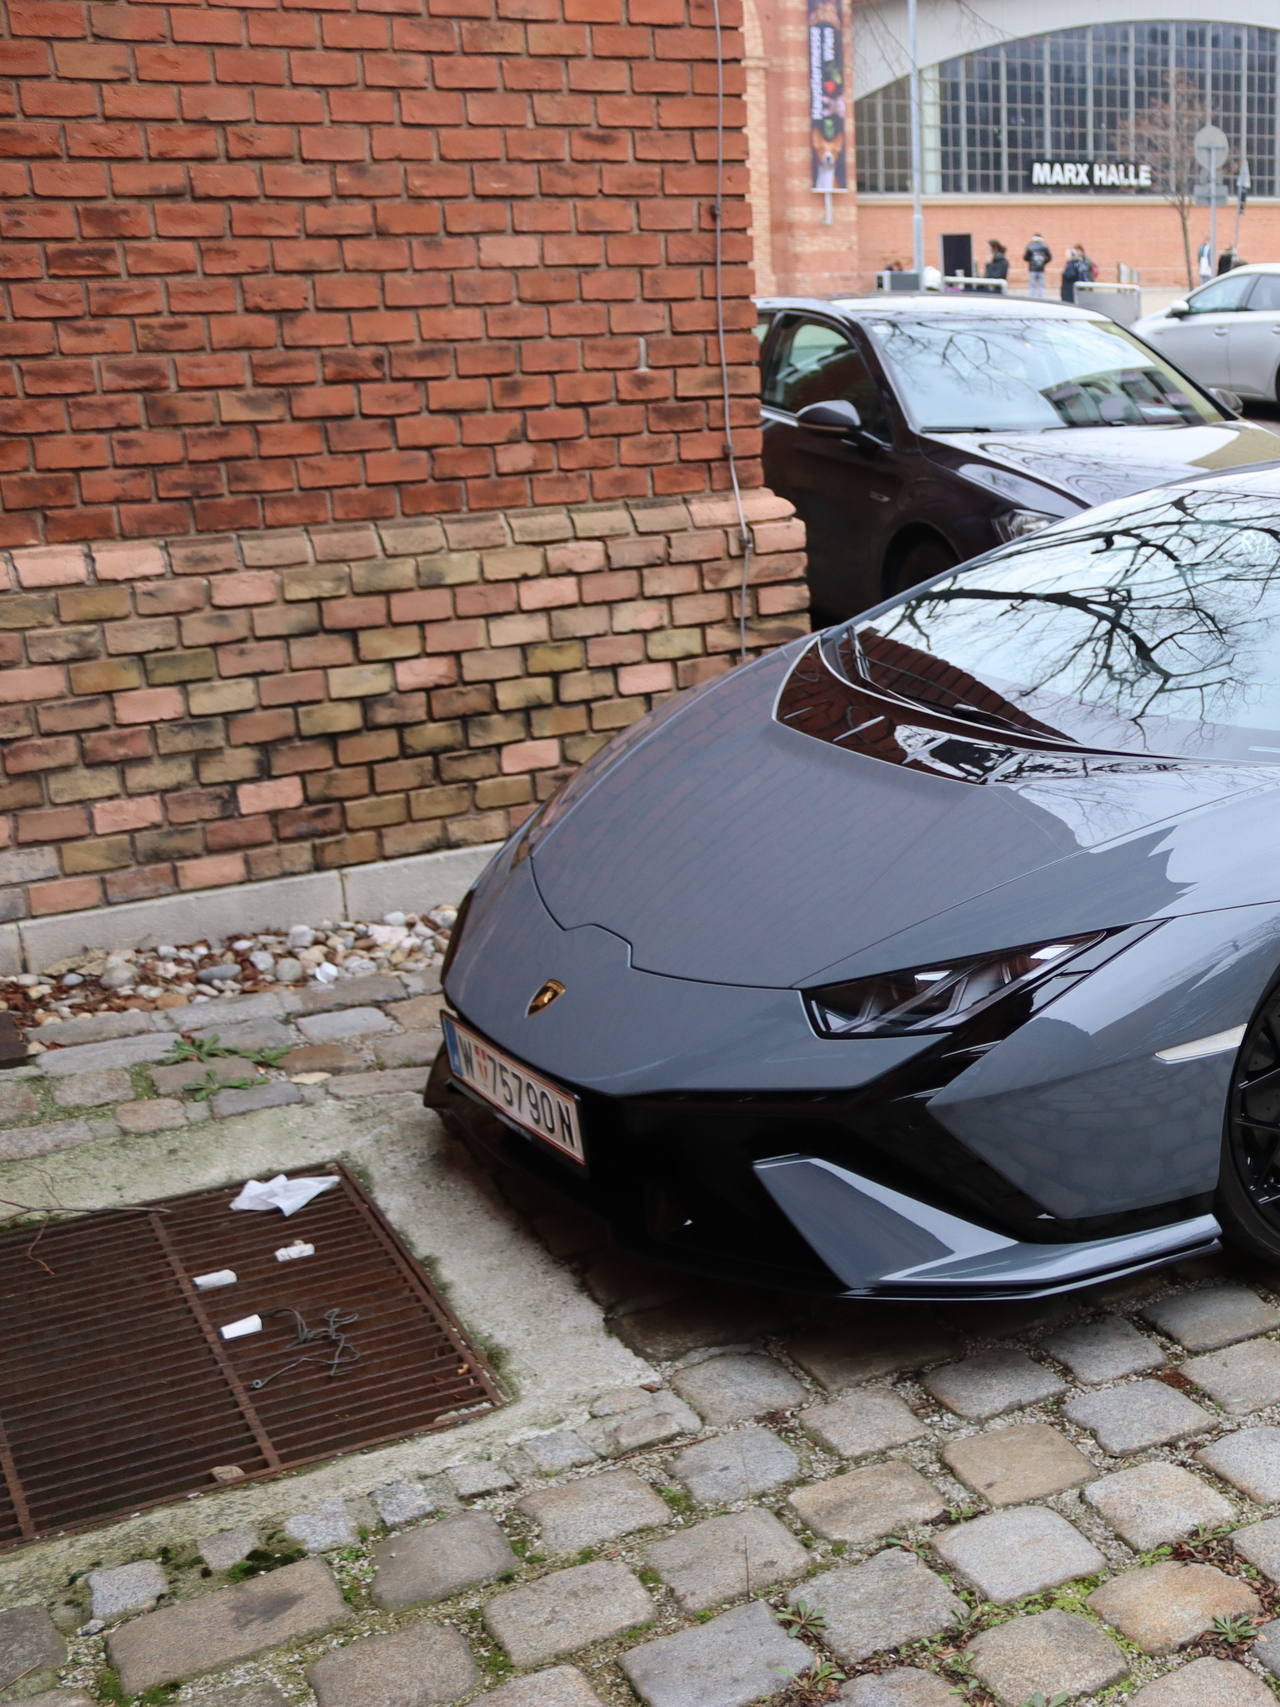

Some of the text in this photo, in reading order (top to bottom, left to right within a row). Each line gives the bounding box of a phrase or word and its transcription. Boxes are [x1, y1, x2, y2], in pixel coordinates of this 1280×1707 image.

[823, 27, 835, 61] Wien
[1032, 162, 1152, 187] MARX HALLE
